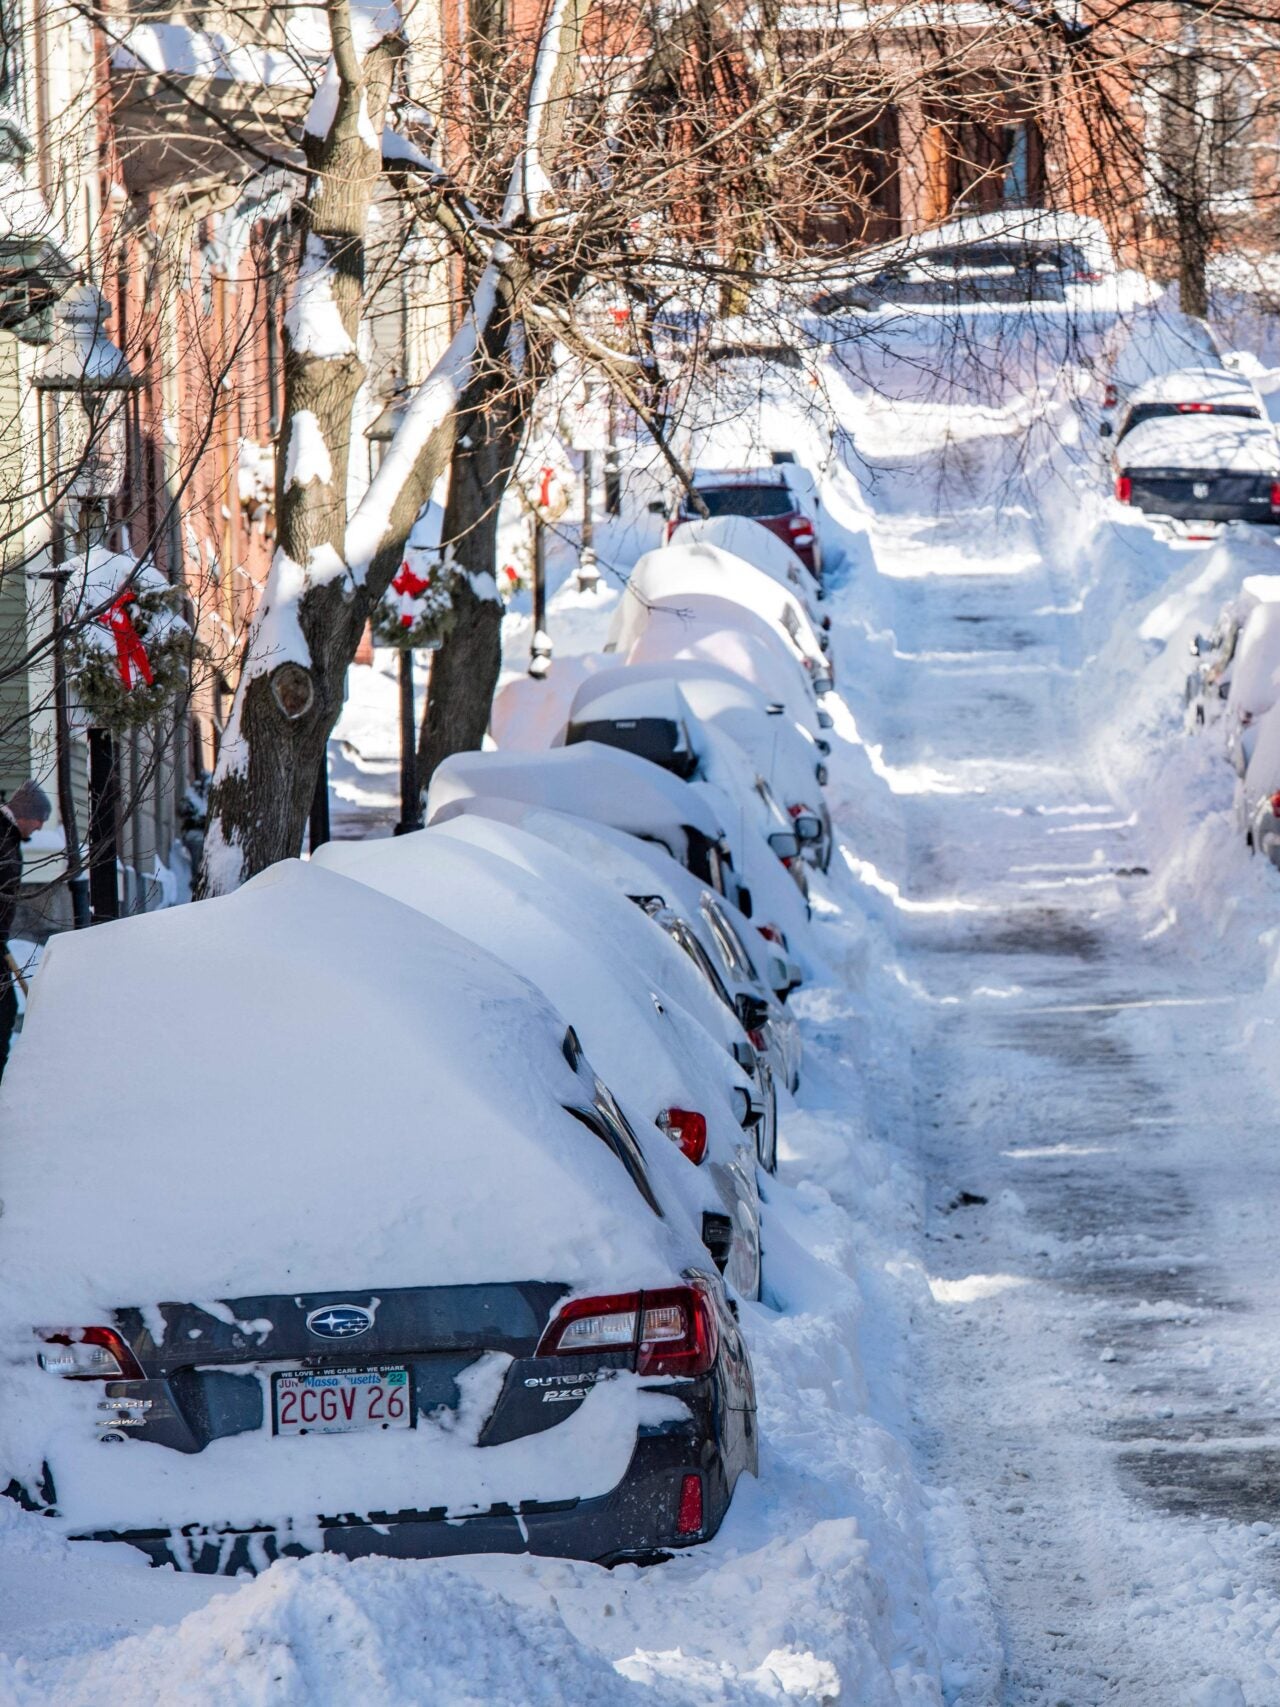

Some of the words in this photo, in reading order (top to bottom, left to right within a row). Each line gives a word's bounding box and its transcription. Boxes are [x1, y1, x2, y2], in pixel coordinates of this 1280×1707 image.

[304, 1374, 382, 1388] Massausetts
[389, 1373, 403, 1383] 22
[281, 1386, 357, 1424] 2CGV
[367, 1385, 404, 1419] 26
